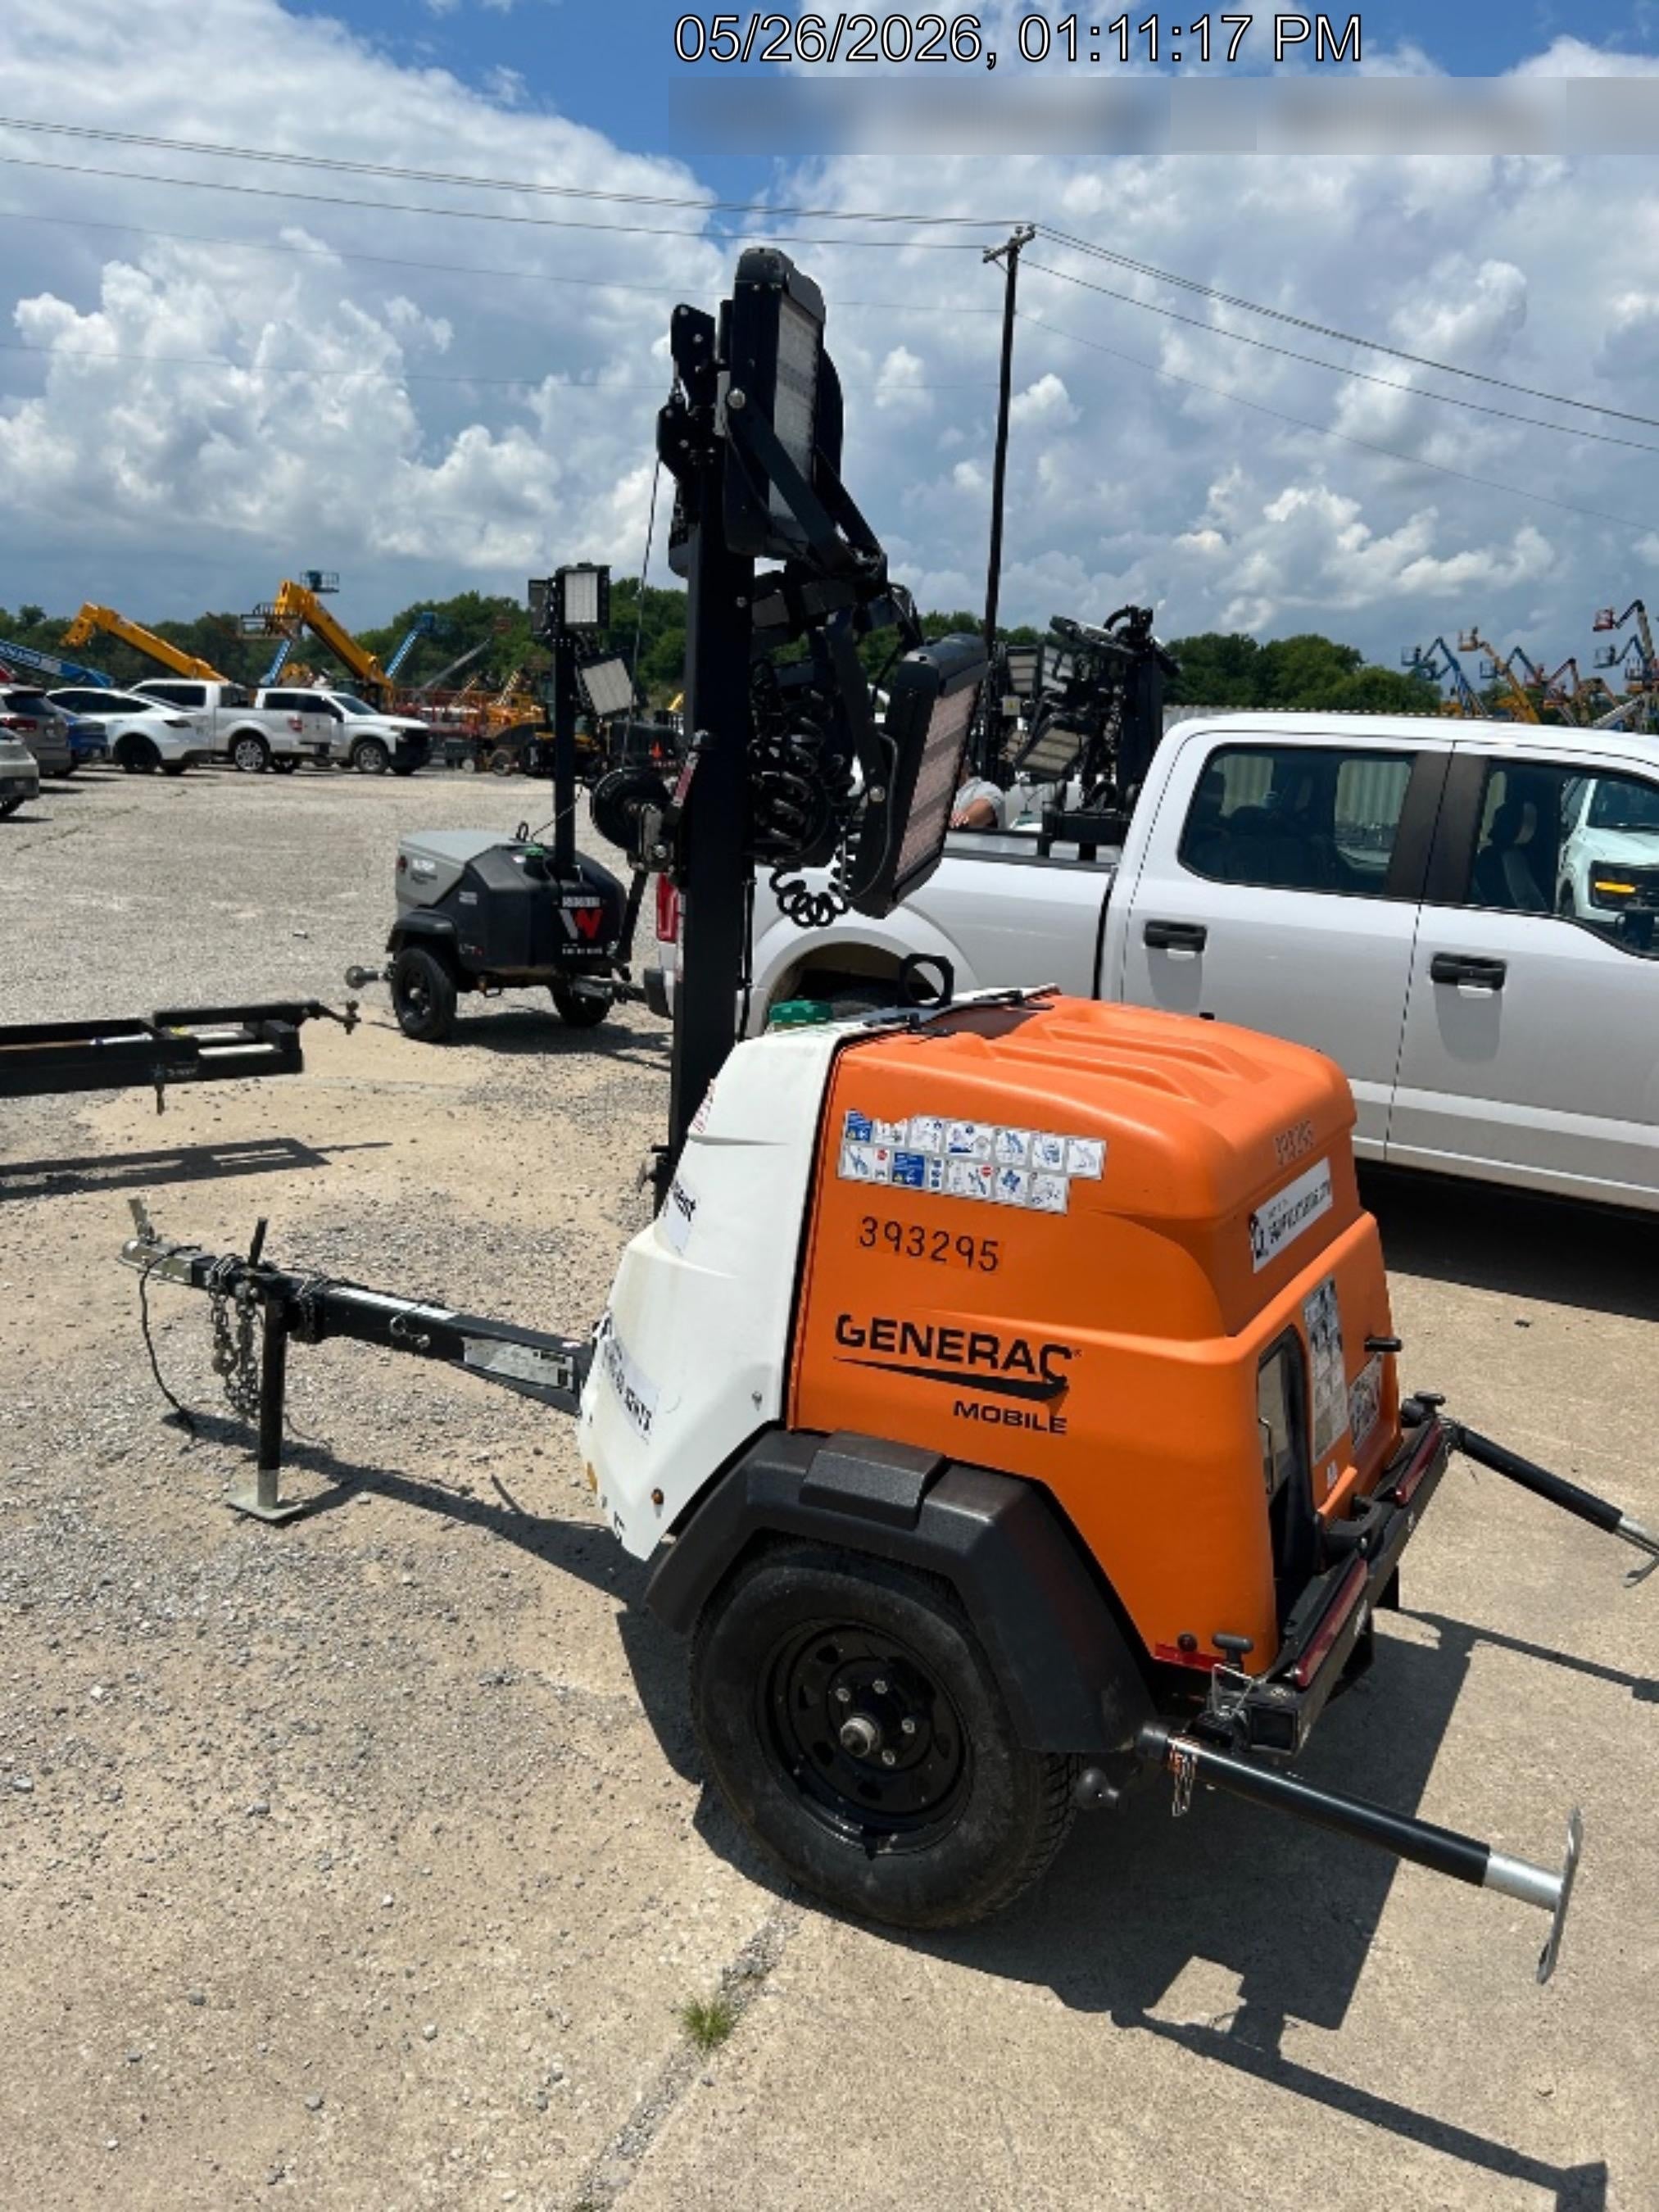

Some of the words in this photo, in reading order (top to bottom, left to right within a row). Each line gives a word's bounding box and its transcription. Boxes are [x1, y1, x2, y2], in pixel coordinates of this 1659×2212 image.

[859, 1217, 999, 1272] 393295
[835, 1313, 1072, 1384] GENERAC
[953, 1400, 1067, 1435] MOBILE
